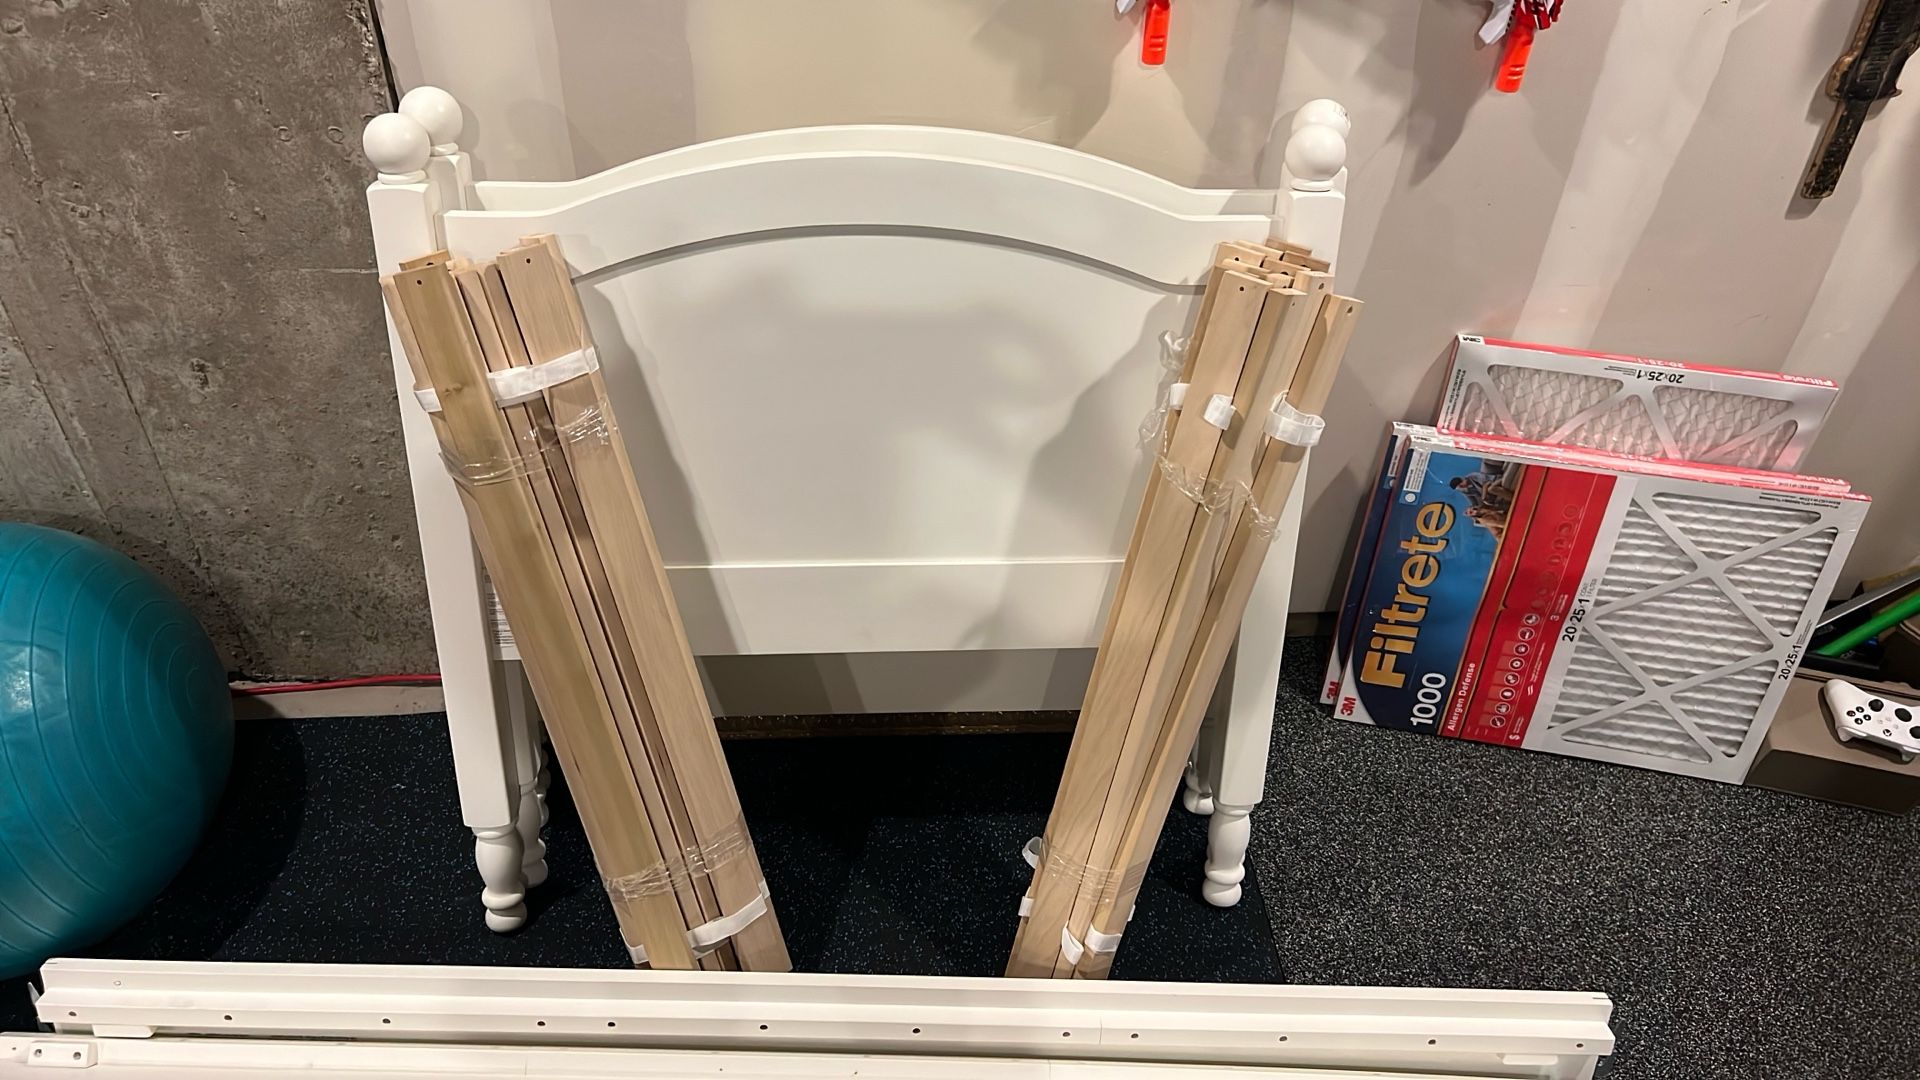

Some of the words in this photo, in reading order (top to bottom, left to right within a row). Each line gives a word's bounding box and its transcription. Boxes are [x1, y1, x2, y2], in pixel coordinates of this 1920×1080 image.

[1636, 369, 1685, 383] 20x25x1
[1360, 502, 1455, 688] Filtrete
[1562, 598, 1590, 642] 20x25x1
[1778, 644, 1802, 680] 20x25x1
[1340, 696, 1356, 716] 3M
[1409, 672, 1446, 726] 1000
[1447, 698, 1465, 731] Allergen
[1459, 662, 1476, 696] Defense
